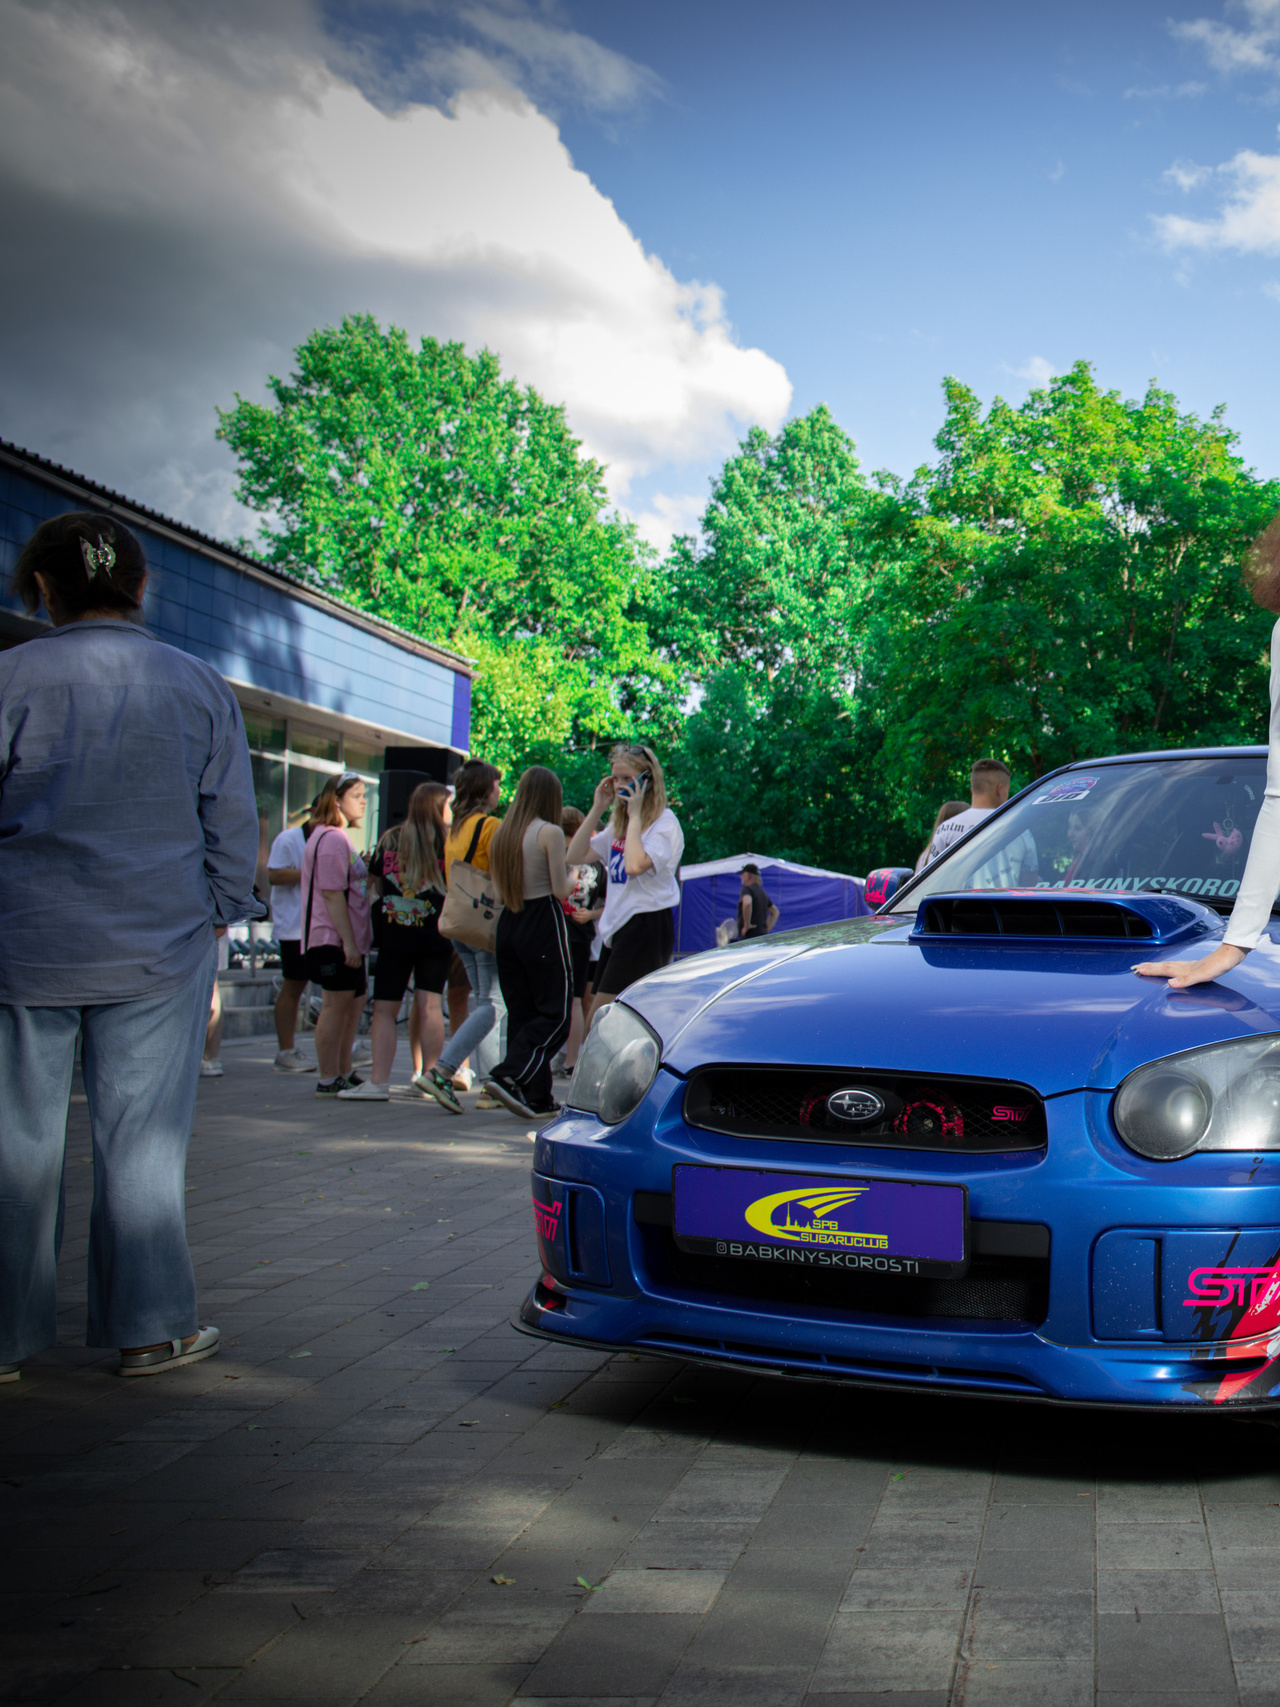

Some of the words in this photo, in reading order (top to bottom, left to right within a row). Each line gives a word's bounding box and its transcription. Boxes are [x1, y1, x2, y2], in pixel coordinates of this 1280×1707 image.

[812, 1219, 839, 1231] SPB
[799, 1232, 889, 1250] SUBARUCLUB
[729, 1242, 920, 1274] BABKINYSKOROSTI
